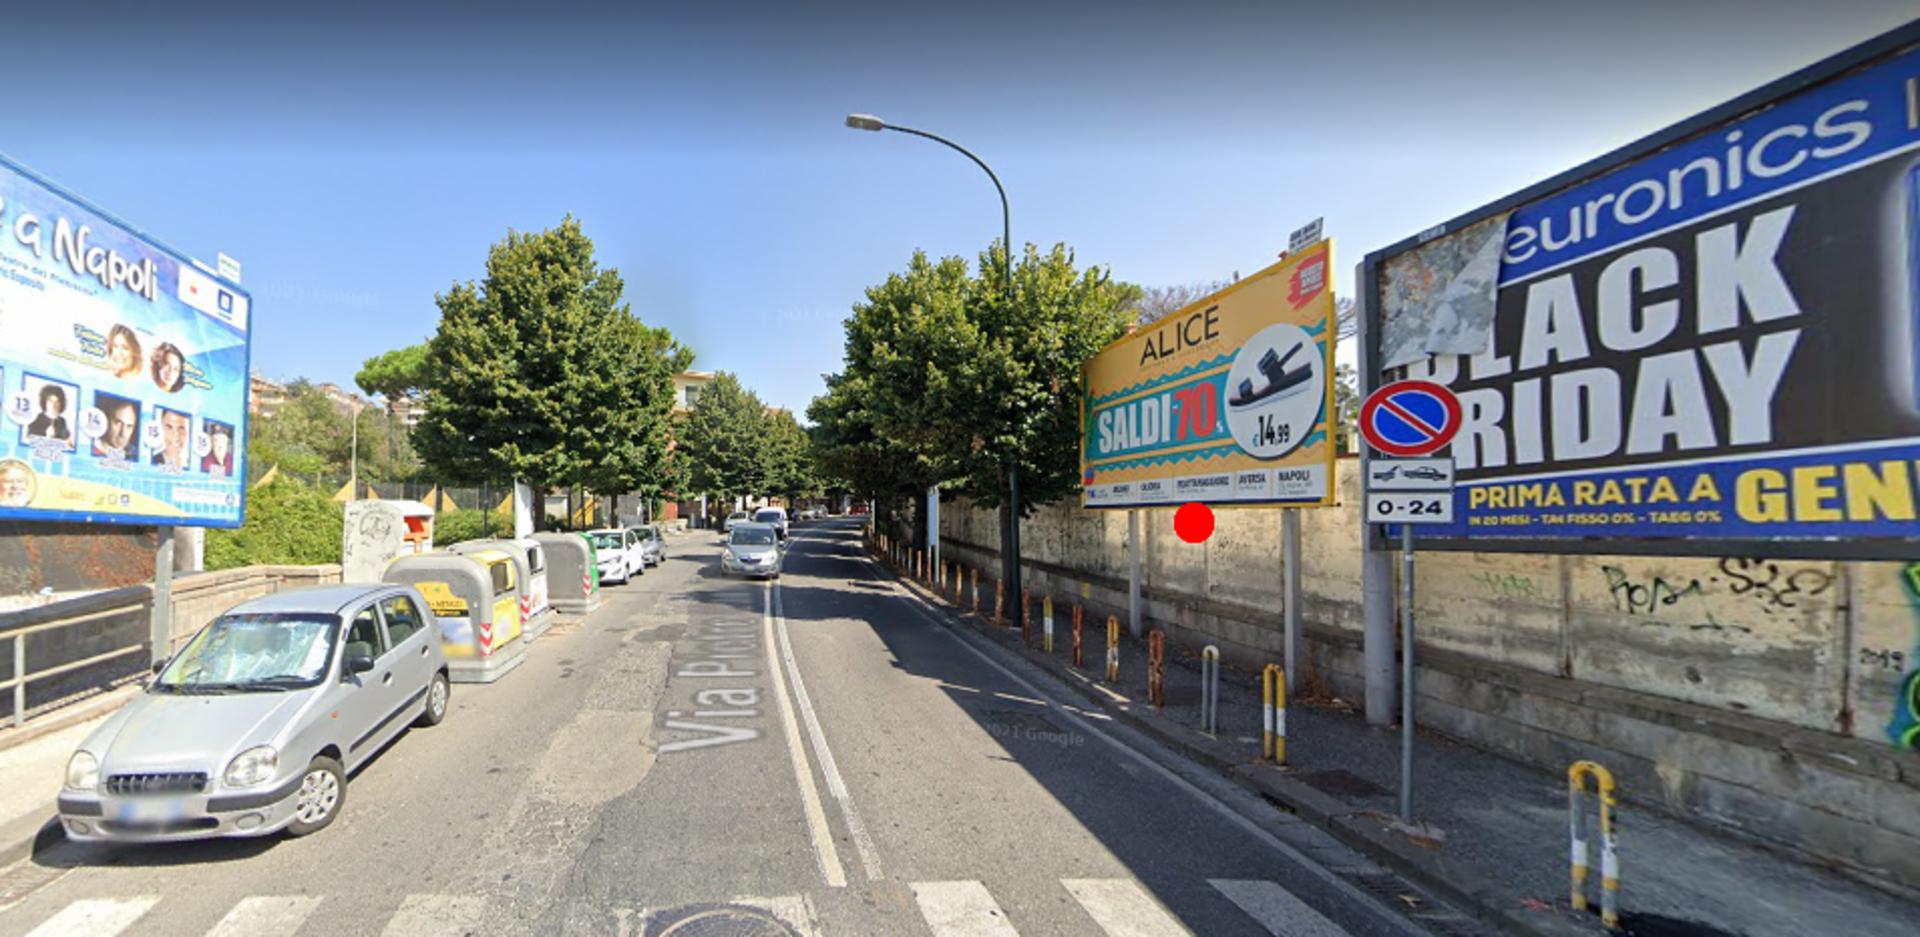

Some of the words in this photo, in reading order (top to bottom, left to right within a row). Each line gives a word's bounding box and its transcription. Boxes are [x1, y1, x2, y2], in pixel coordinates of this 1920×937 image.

[1503, 100, 1872, 264] euronics
[15, 213, 41, 257] a
[54, 217, 158, 302] Napoli
[1408, 203, 1802, 386] LACK
[1140, 304, 1219, 366] ALICE
[16, 396, 31, 412] 13
[87, 411, 100, 426] 14
[1099, 393, 1170, 454] SALDI
[1451, 327, 1802, 470] RIDAY
[1278, 470, 1310, 481] NAPOLI
[1469, 483, 1565, 509] PRIMA
[1573, 476, 1679, 506] RATA
[1688, 473, 1721, 502] A
[1735, 460, 1920, 524] GEN
[1468, 516, 1480, 525] IN
[1483, 515, 1498, 525] 20
[1500, 514, 1531, 525] MESI
[1567, 513, 1609, 524] FISSO
[1611, 512, 1635, 524] 0%
[1650, 511, 1692, 523] TAEG
[1694, 511, 1721, 523] 0%
